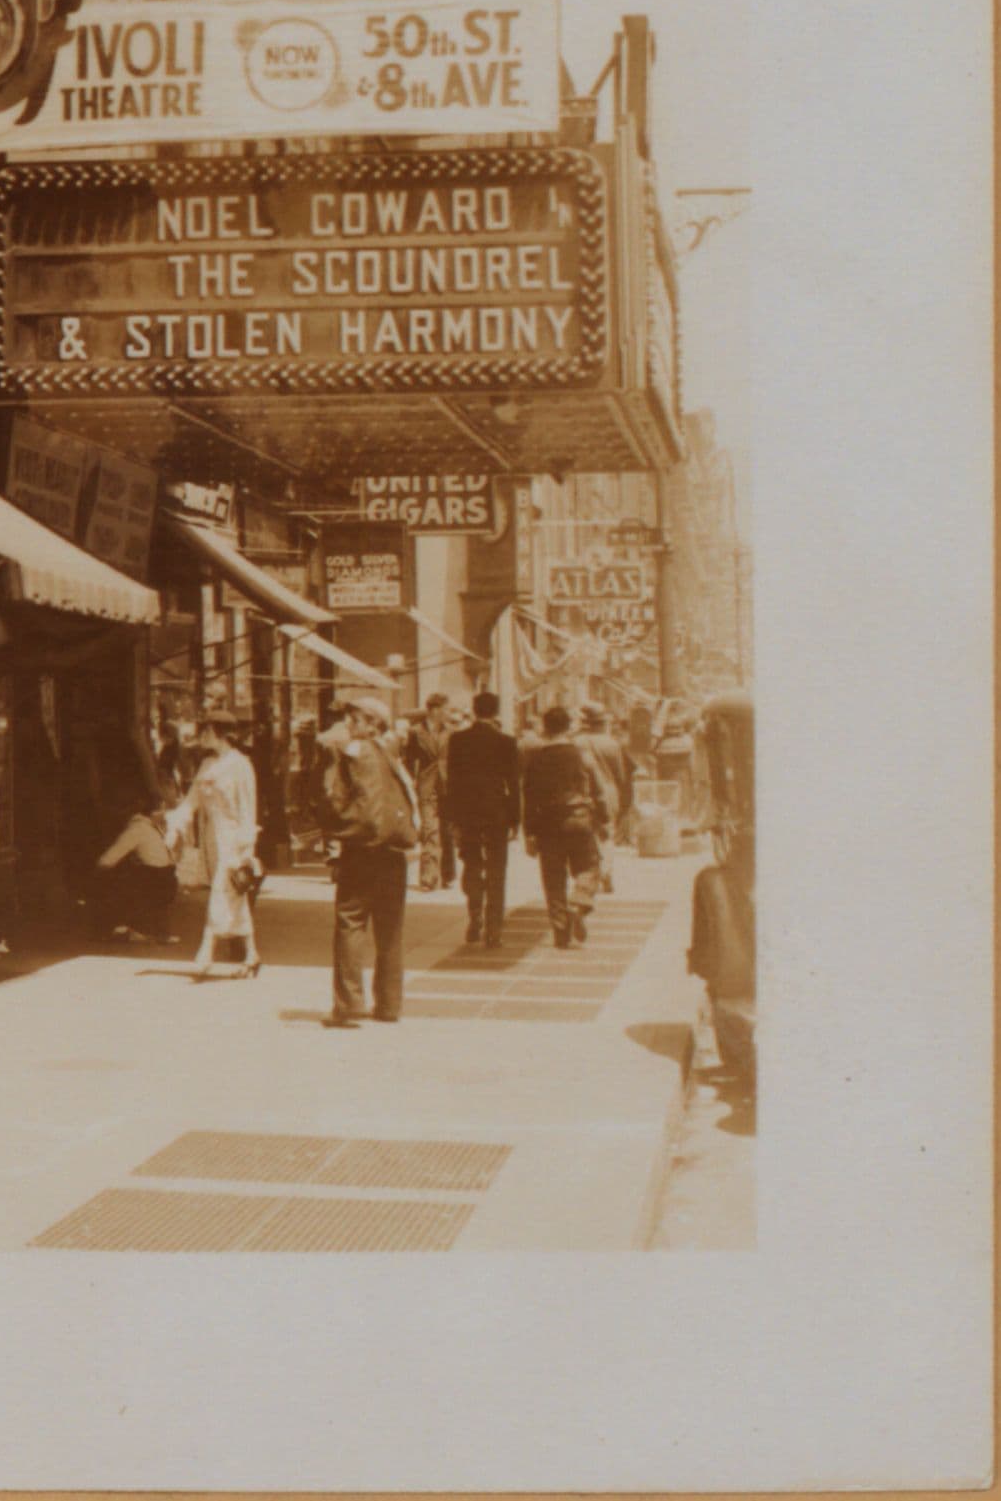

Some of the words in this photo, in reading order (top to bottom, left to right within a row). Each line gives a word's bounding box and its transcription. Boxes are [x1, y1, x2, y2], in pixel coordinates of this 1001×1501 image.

[264, 45, 321, 65] NOW
[362, 14, 456, 58] 50th
[462, 9, 522, 56] ST.
[61, 82, 203, 123] THEATRE
[373, 62, 437, 112] 8th
[442, 60, 529, 108] AVE.
[157, 195, 274, 241] NOEL
[310, 187, 511, 236] COWARD
[169, 253, 256, 298] THE
[290, 244, 574, 296] SCOUNDREL
[58, 317, 88, 360] &
[124, 311, 302, 359] STOLEN
[339, 306, 575, 356] HARMONY
[366, 496, 488, 526] CIGARS
[326, 555, 356, 567] GOLD
[553, 570, 640, 596] ATLAS
